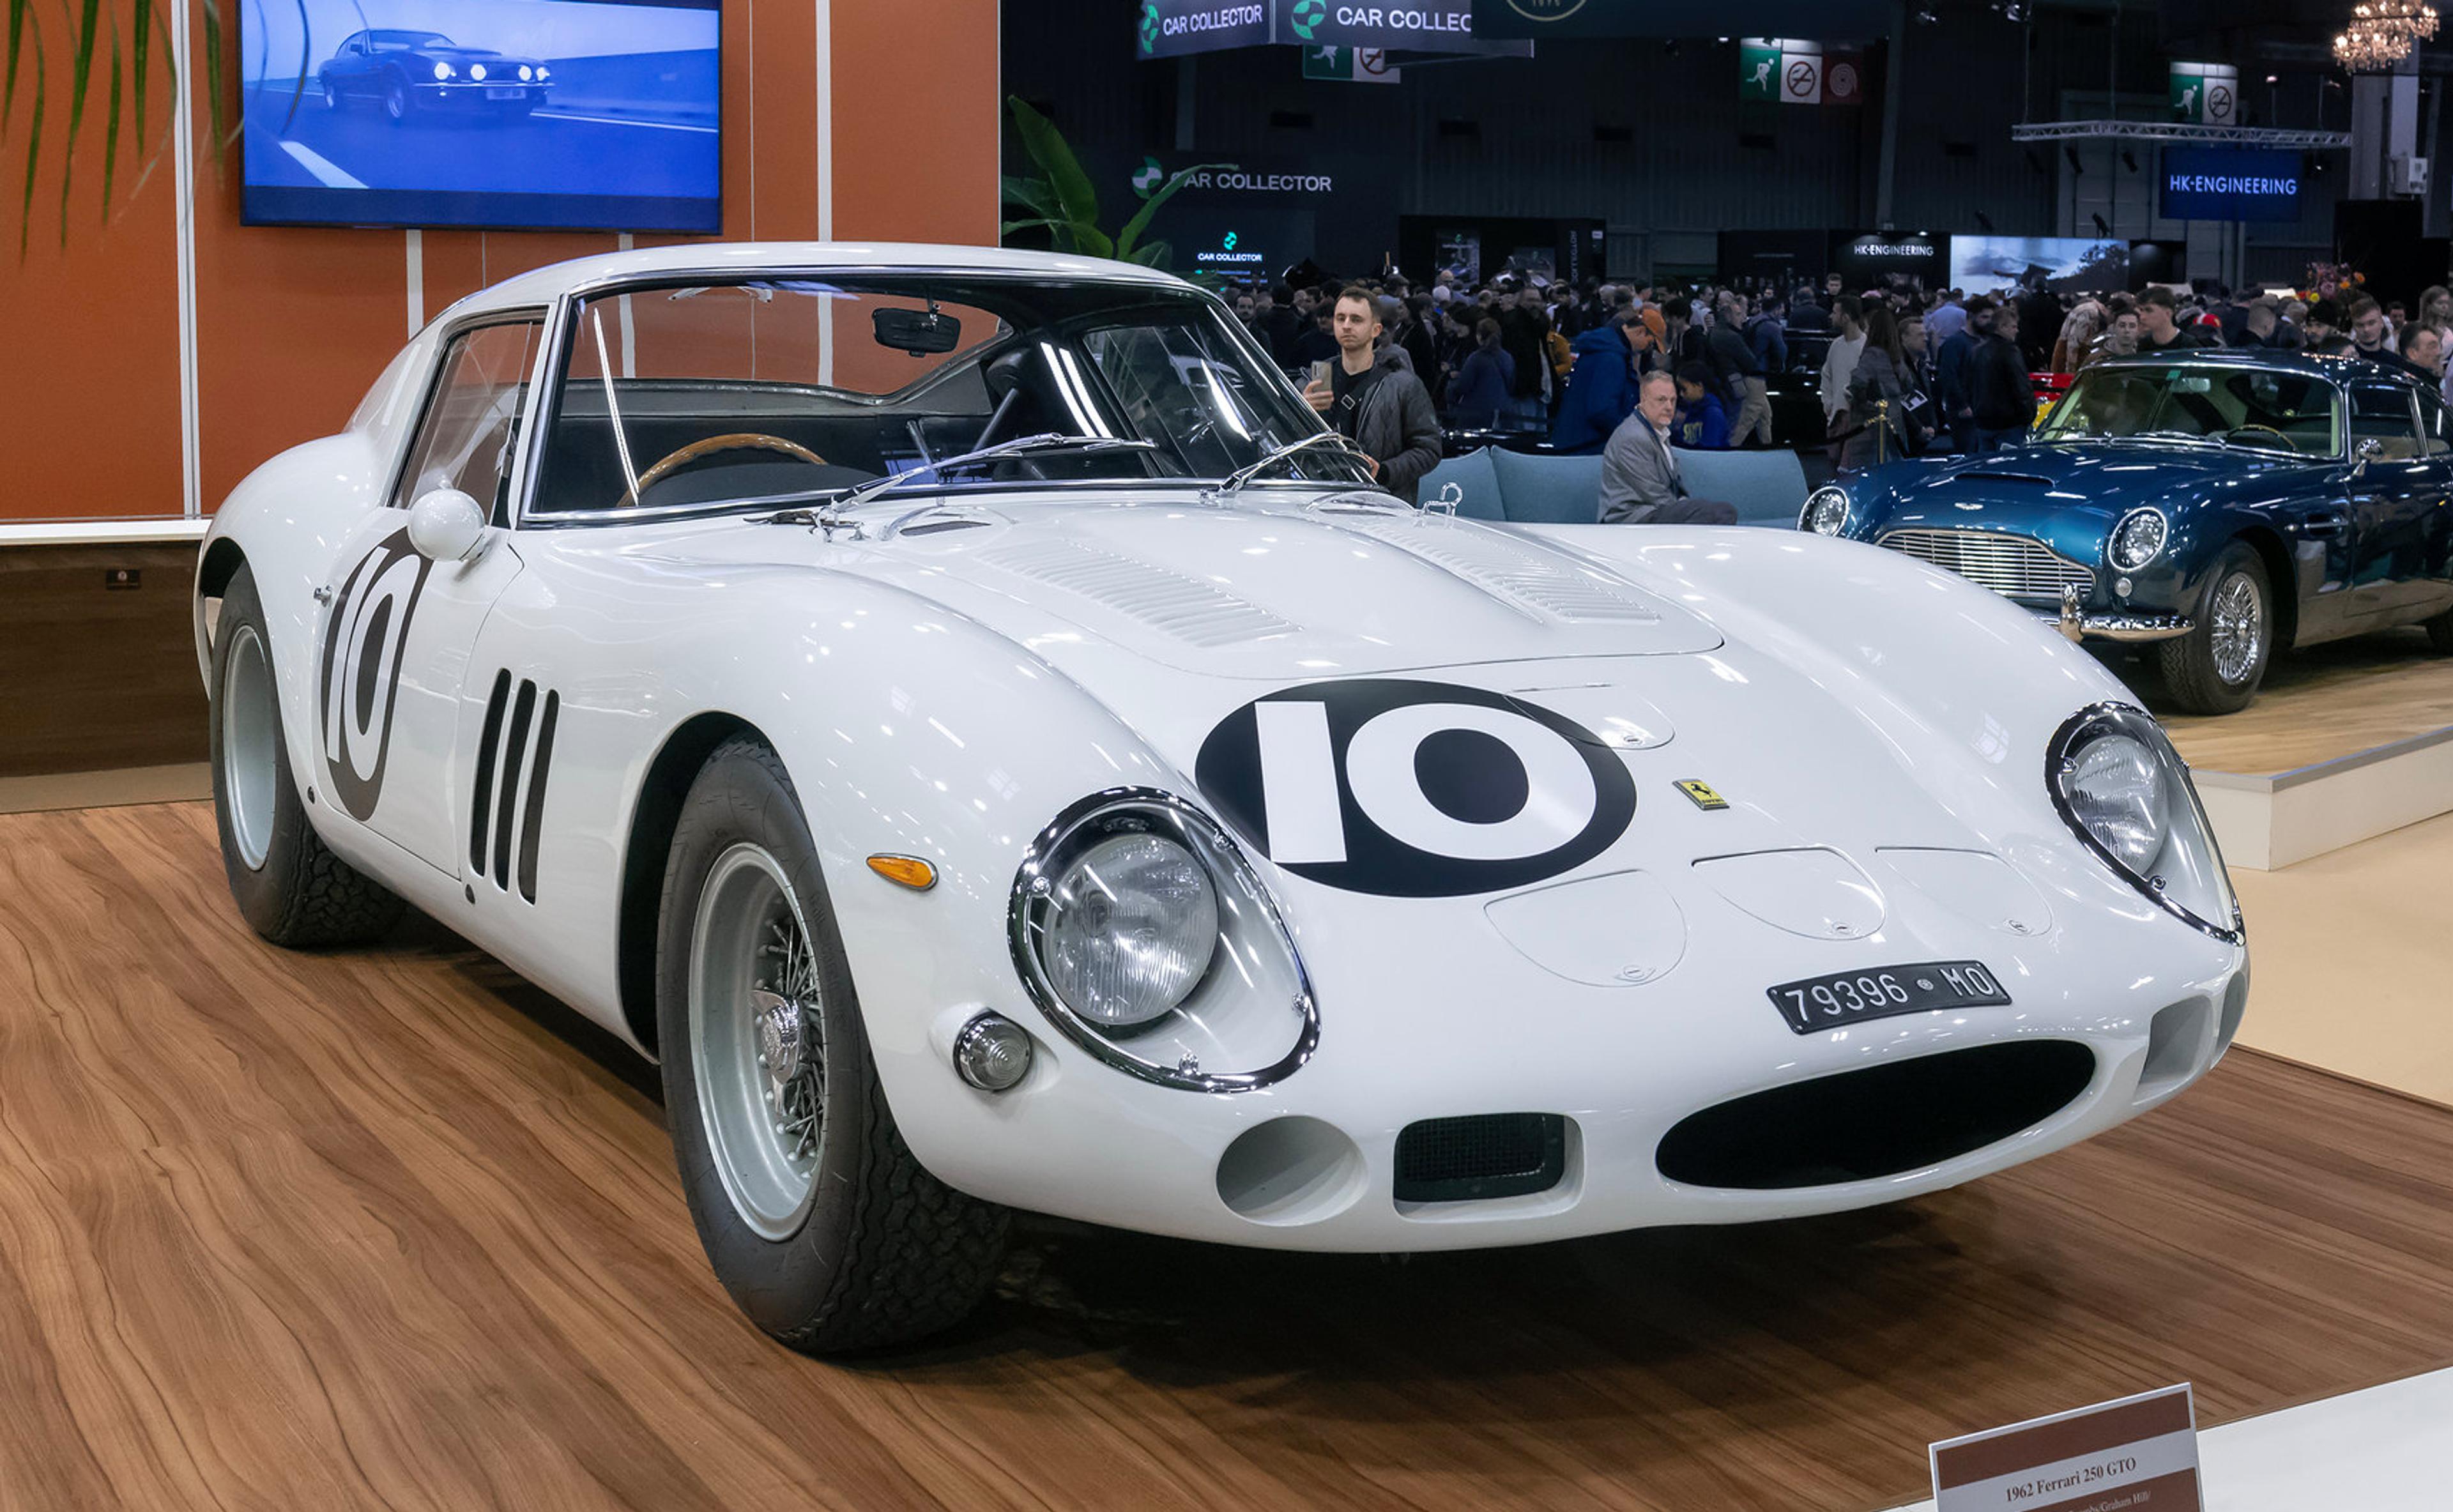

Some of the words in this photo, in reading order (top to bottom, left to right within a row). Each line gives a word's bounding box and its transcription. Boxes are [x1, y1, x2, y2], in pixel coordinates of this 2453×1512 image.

[1163, 16, 1188, 36] CAR
[1190, 4, 1263, 32] COLLECTOR
[1336, 6, 1383, 27] CAR
[1216, 173, 1332, 192] COLLECTOR
[2169, 174, 2297, 195] HK-ENGINEERING
[1198, 252, 1215, 261] CAR
[1216, 253, 1263, 261] COLLECTOR
[1854, 245, 1934, 256] HK-ENGINEERING
[327, 546, 422, 782] 10
[1254, 701, 1596, 863] 10
[1784, 974, 1909, 1022] 79396
[1938, 966, 1994, 997] MO
[2006, 1482, 2034, 1502] 1962
[2037, 1470, 2081, 1494] Ferrari
[2084, 1465, 2104, 1483] 250
[2107, 1457, 2137, 1476] GTO
